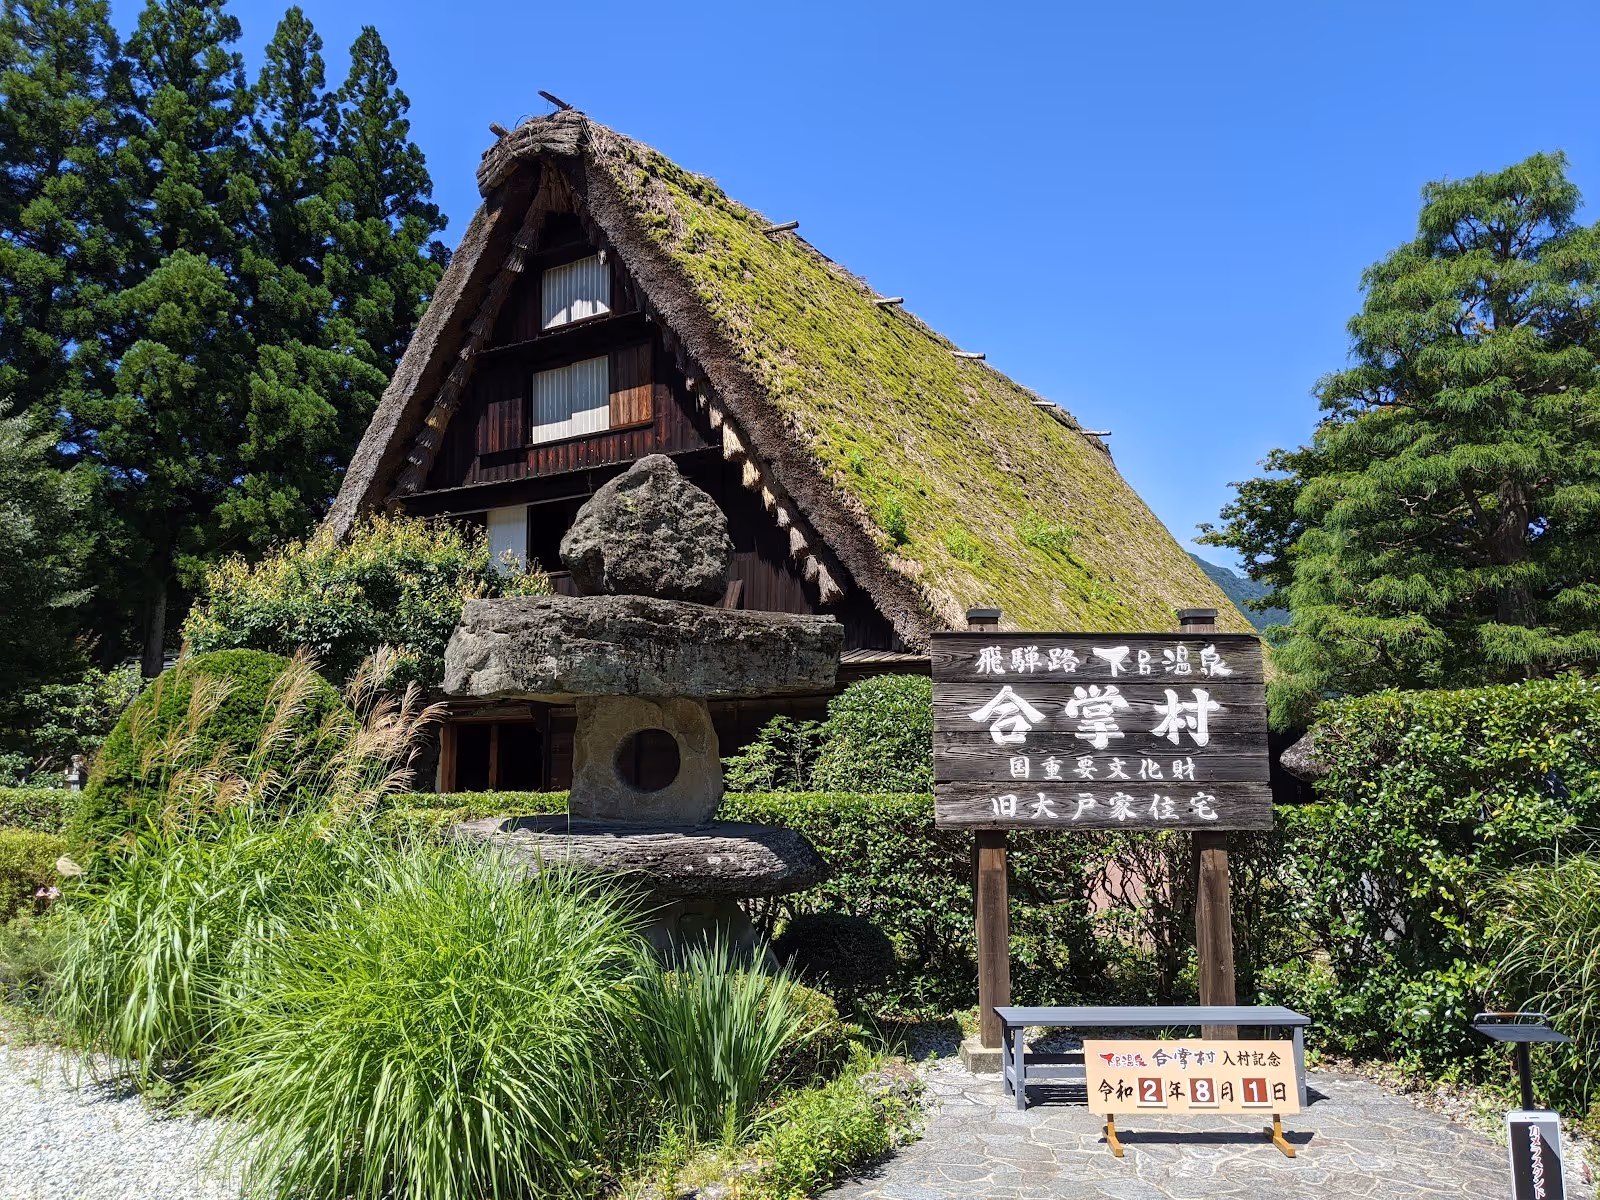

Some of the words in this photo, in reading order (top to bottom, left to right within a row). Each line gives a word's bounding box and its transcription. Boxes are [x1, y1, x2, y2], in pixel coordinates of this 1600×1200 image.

[968, 685, 1220, 749] 合掌村
[1010, 756, 1196, 781] 国重要文化財
[991, 791, 1219, 821] 旧大戸家住宅
[1222, 1051, 1281, 1067] 入村記念
[1097, 1079, 1287, 1102] 令和2年8月1日
[1528, 1125, 1546, 1199] カメラスタンド
